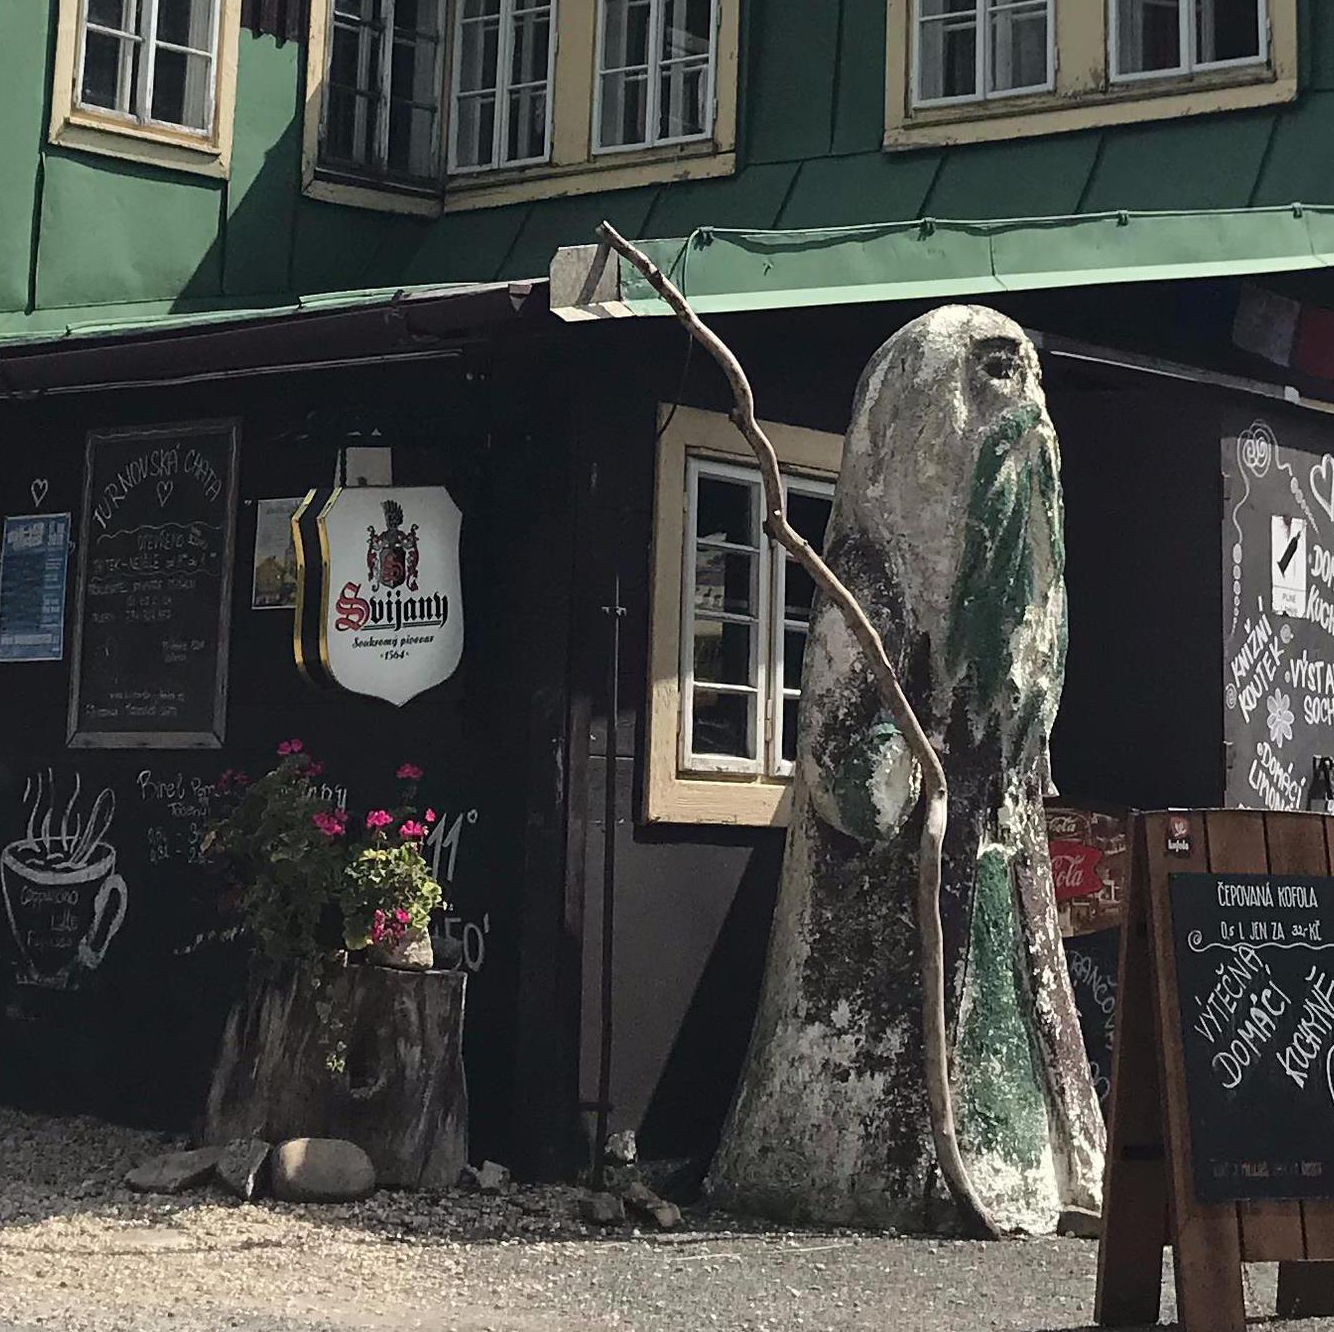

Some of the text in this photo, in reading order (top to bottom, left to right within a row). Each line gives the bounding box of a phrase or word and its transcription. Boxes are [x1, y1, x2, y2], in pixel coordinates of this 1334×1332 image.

[92, 443, 222, 530] TURNOVSKÁ CHATA
[335, 581, 449, 633] Svijany
[1230, 596, 1273, 687] KNIŽNÍ
[1237, 635, 1284, 724] KOUTEK
[1261, 741, 1307, 810] DOMÁCÍ
[1217, 881, 1319, 908] ČEPOVANÁ KOFOLA
[1238, 921, 1245, 940] L
[1249, 921, 1268, 941] JEN
[1271, 921, 1285, 941] ZA
[1194, 944, 1265, 1044] VÝTEČNÁ
[1211, 964, 1292, 1089] DOMÁCÍ
